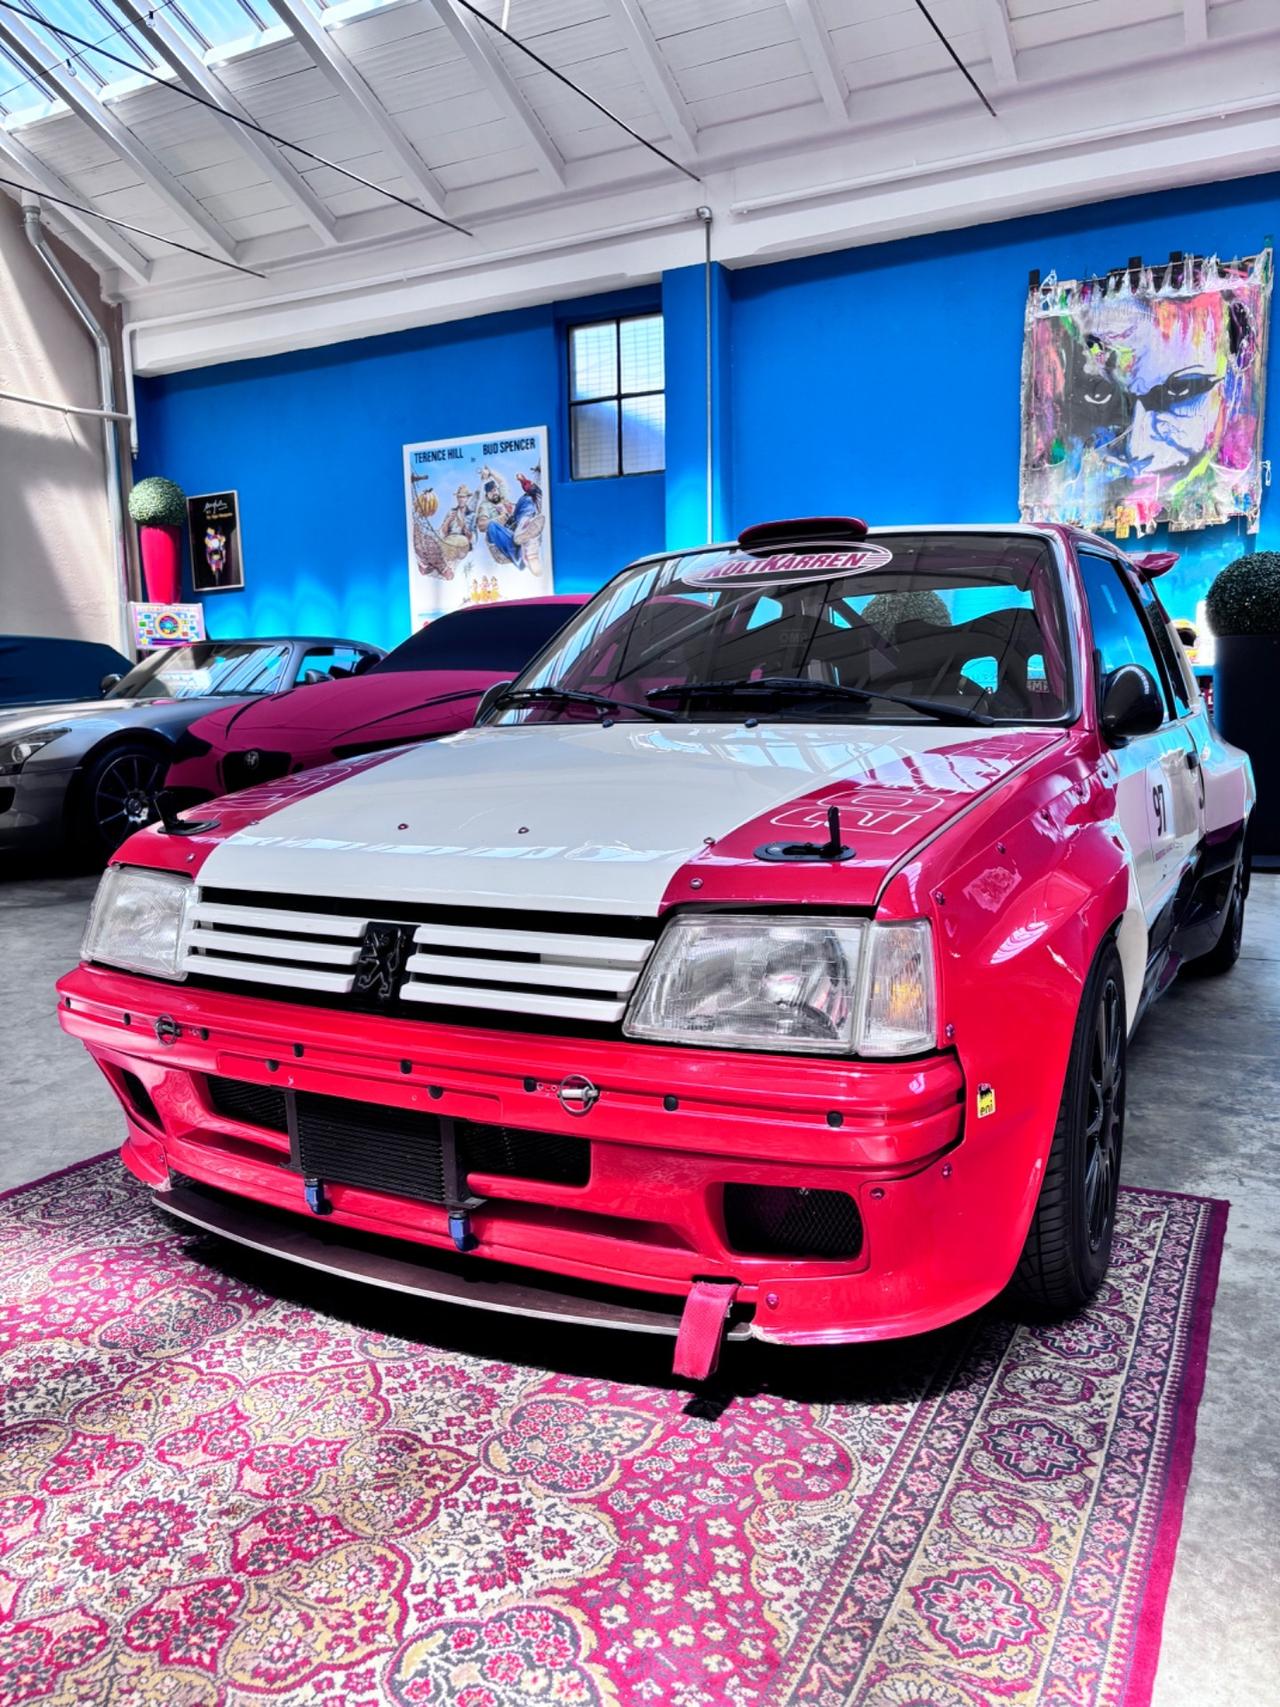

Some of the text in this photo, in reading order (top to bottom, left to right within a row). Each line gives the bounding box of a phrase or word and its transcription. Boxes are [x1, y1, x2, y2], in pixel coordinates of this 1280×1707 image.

[414, 449, 446, 464] TERENCE
[447, 448, 464, 460] HILL
[483, 438, 536, 456] BUD SPENCER
[703, 553, 867, 579] KULTKARREN
[1152, 784, 1167, 836] 97
[980, 1100, 993, 1116] eni
